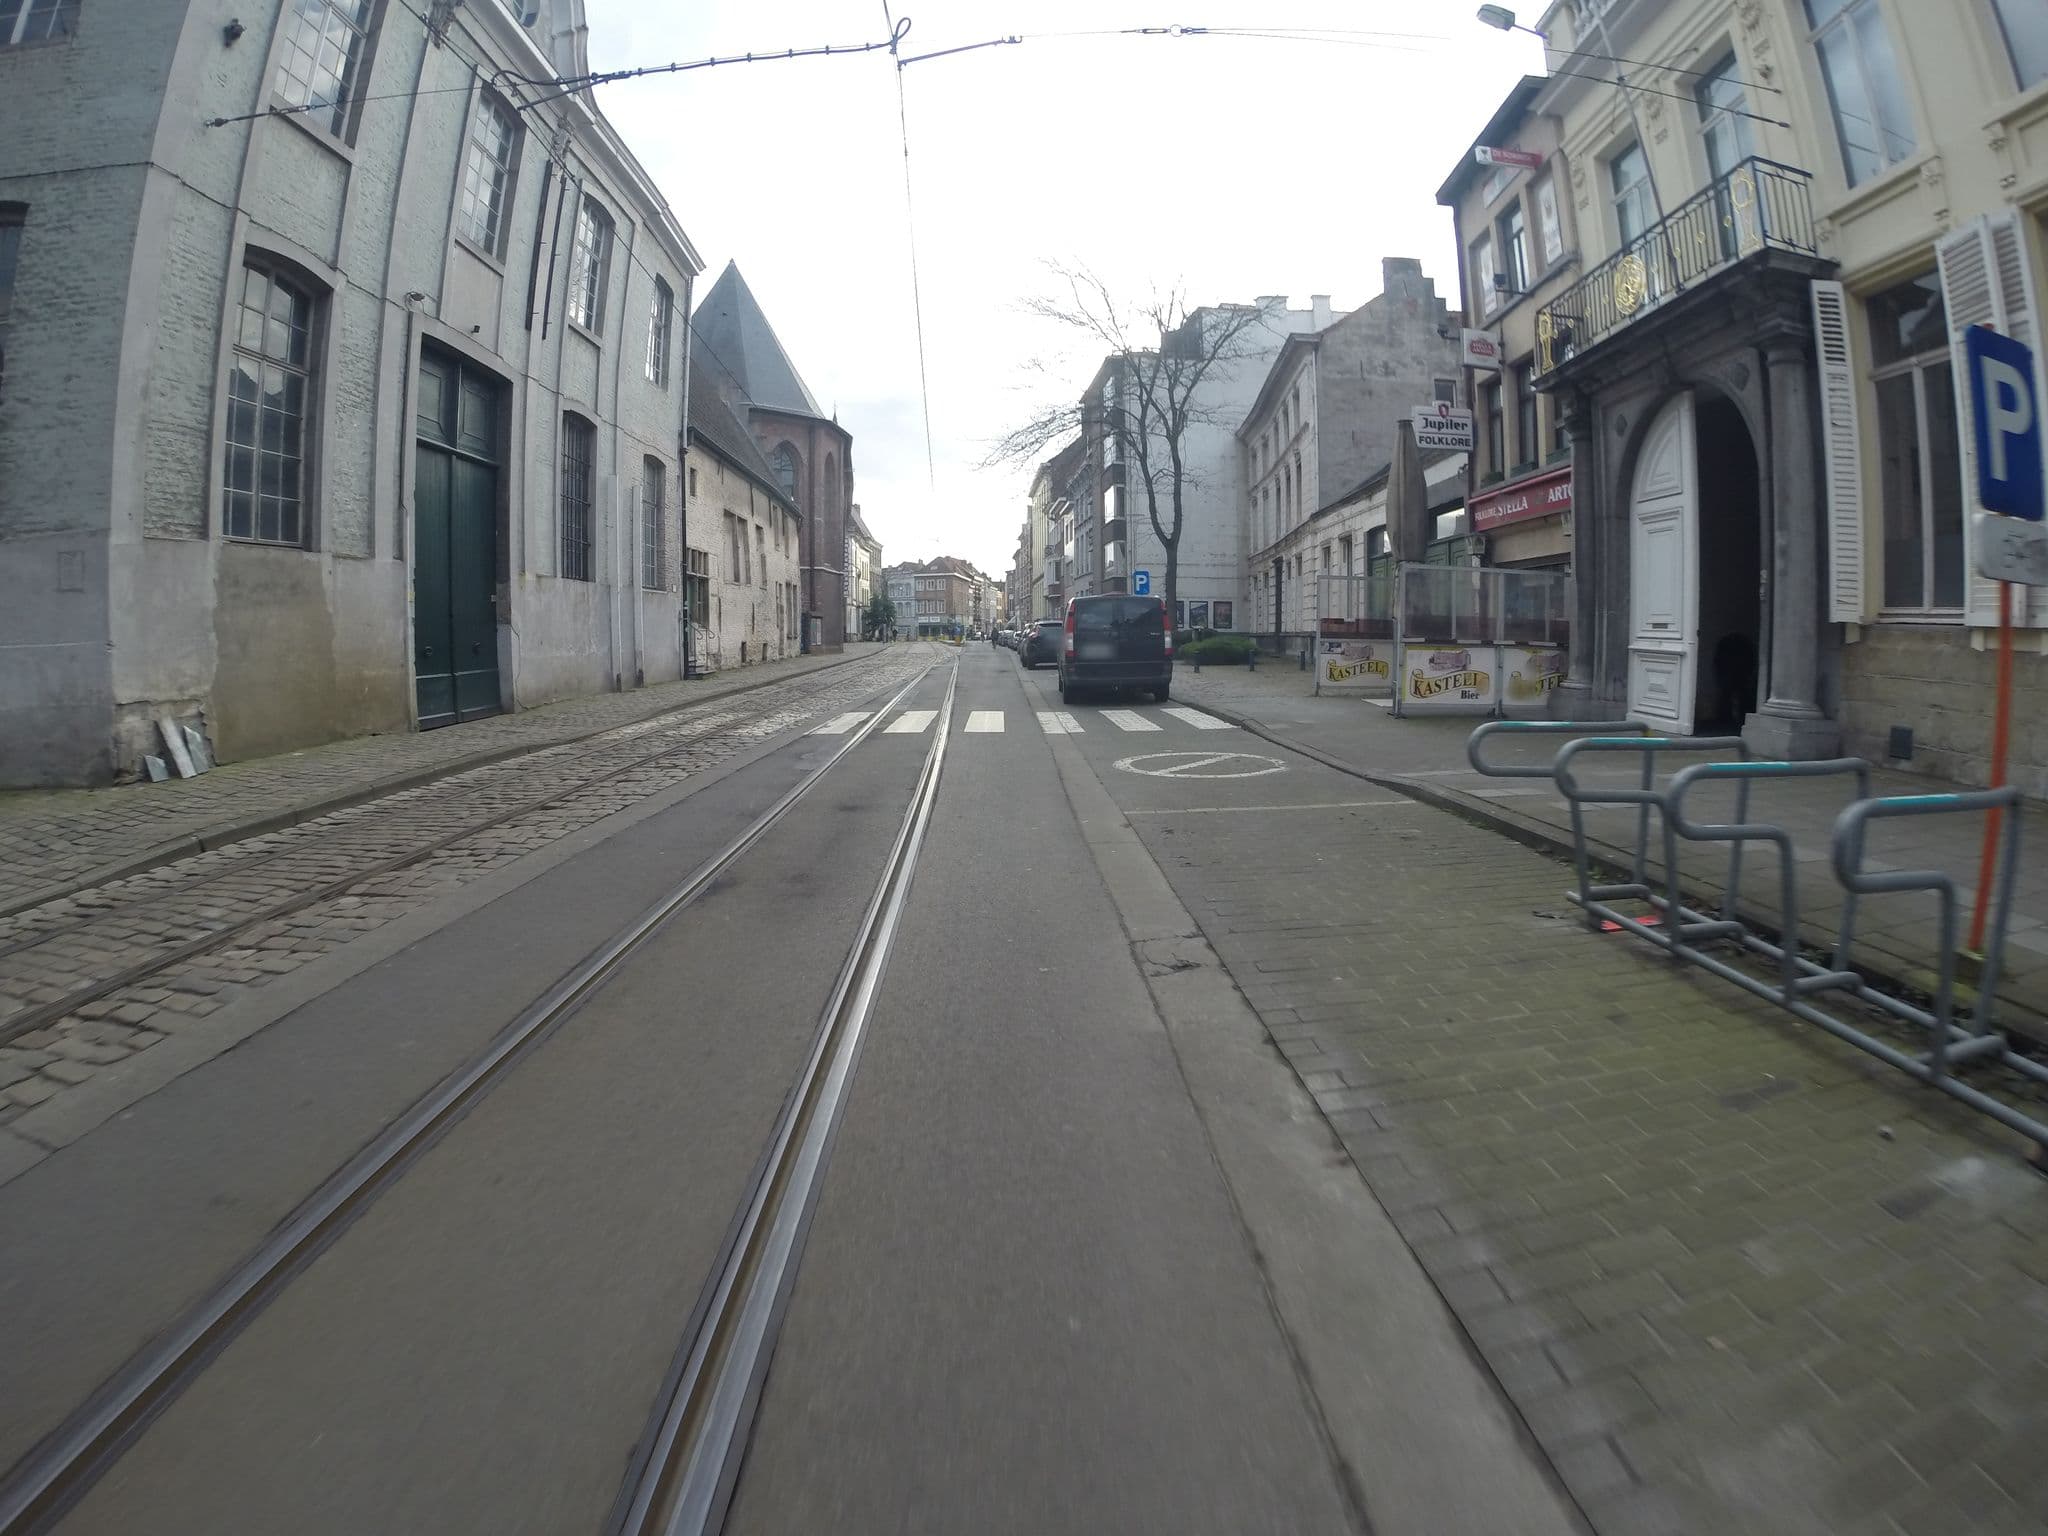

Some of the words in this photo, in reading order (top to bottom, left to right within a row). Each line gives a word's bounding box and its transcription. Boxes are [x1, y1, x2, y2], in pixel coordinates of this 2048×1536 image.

[1423, 417, 1468, 431] Jupiler
[1980, 355, 2033, 481] P
[1418, 435, 1471, 447] FOLKLORE
[1498, 496, 1528, 516] STELLA
[1135, 574, 1148, 592] P
[1328, 661, 1382, 681] KASTEEL
[1461, 690, 1480, 700] Bier
